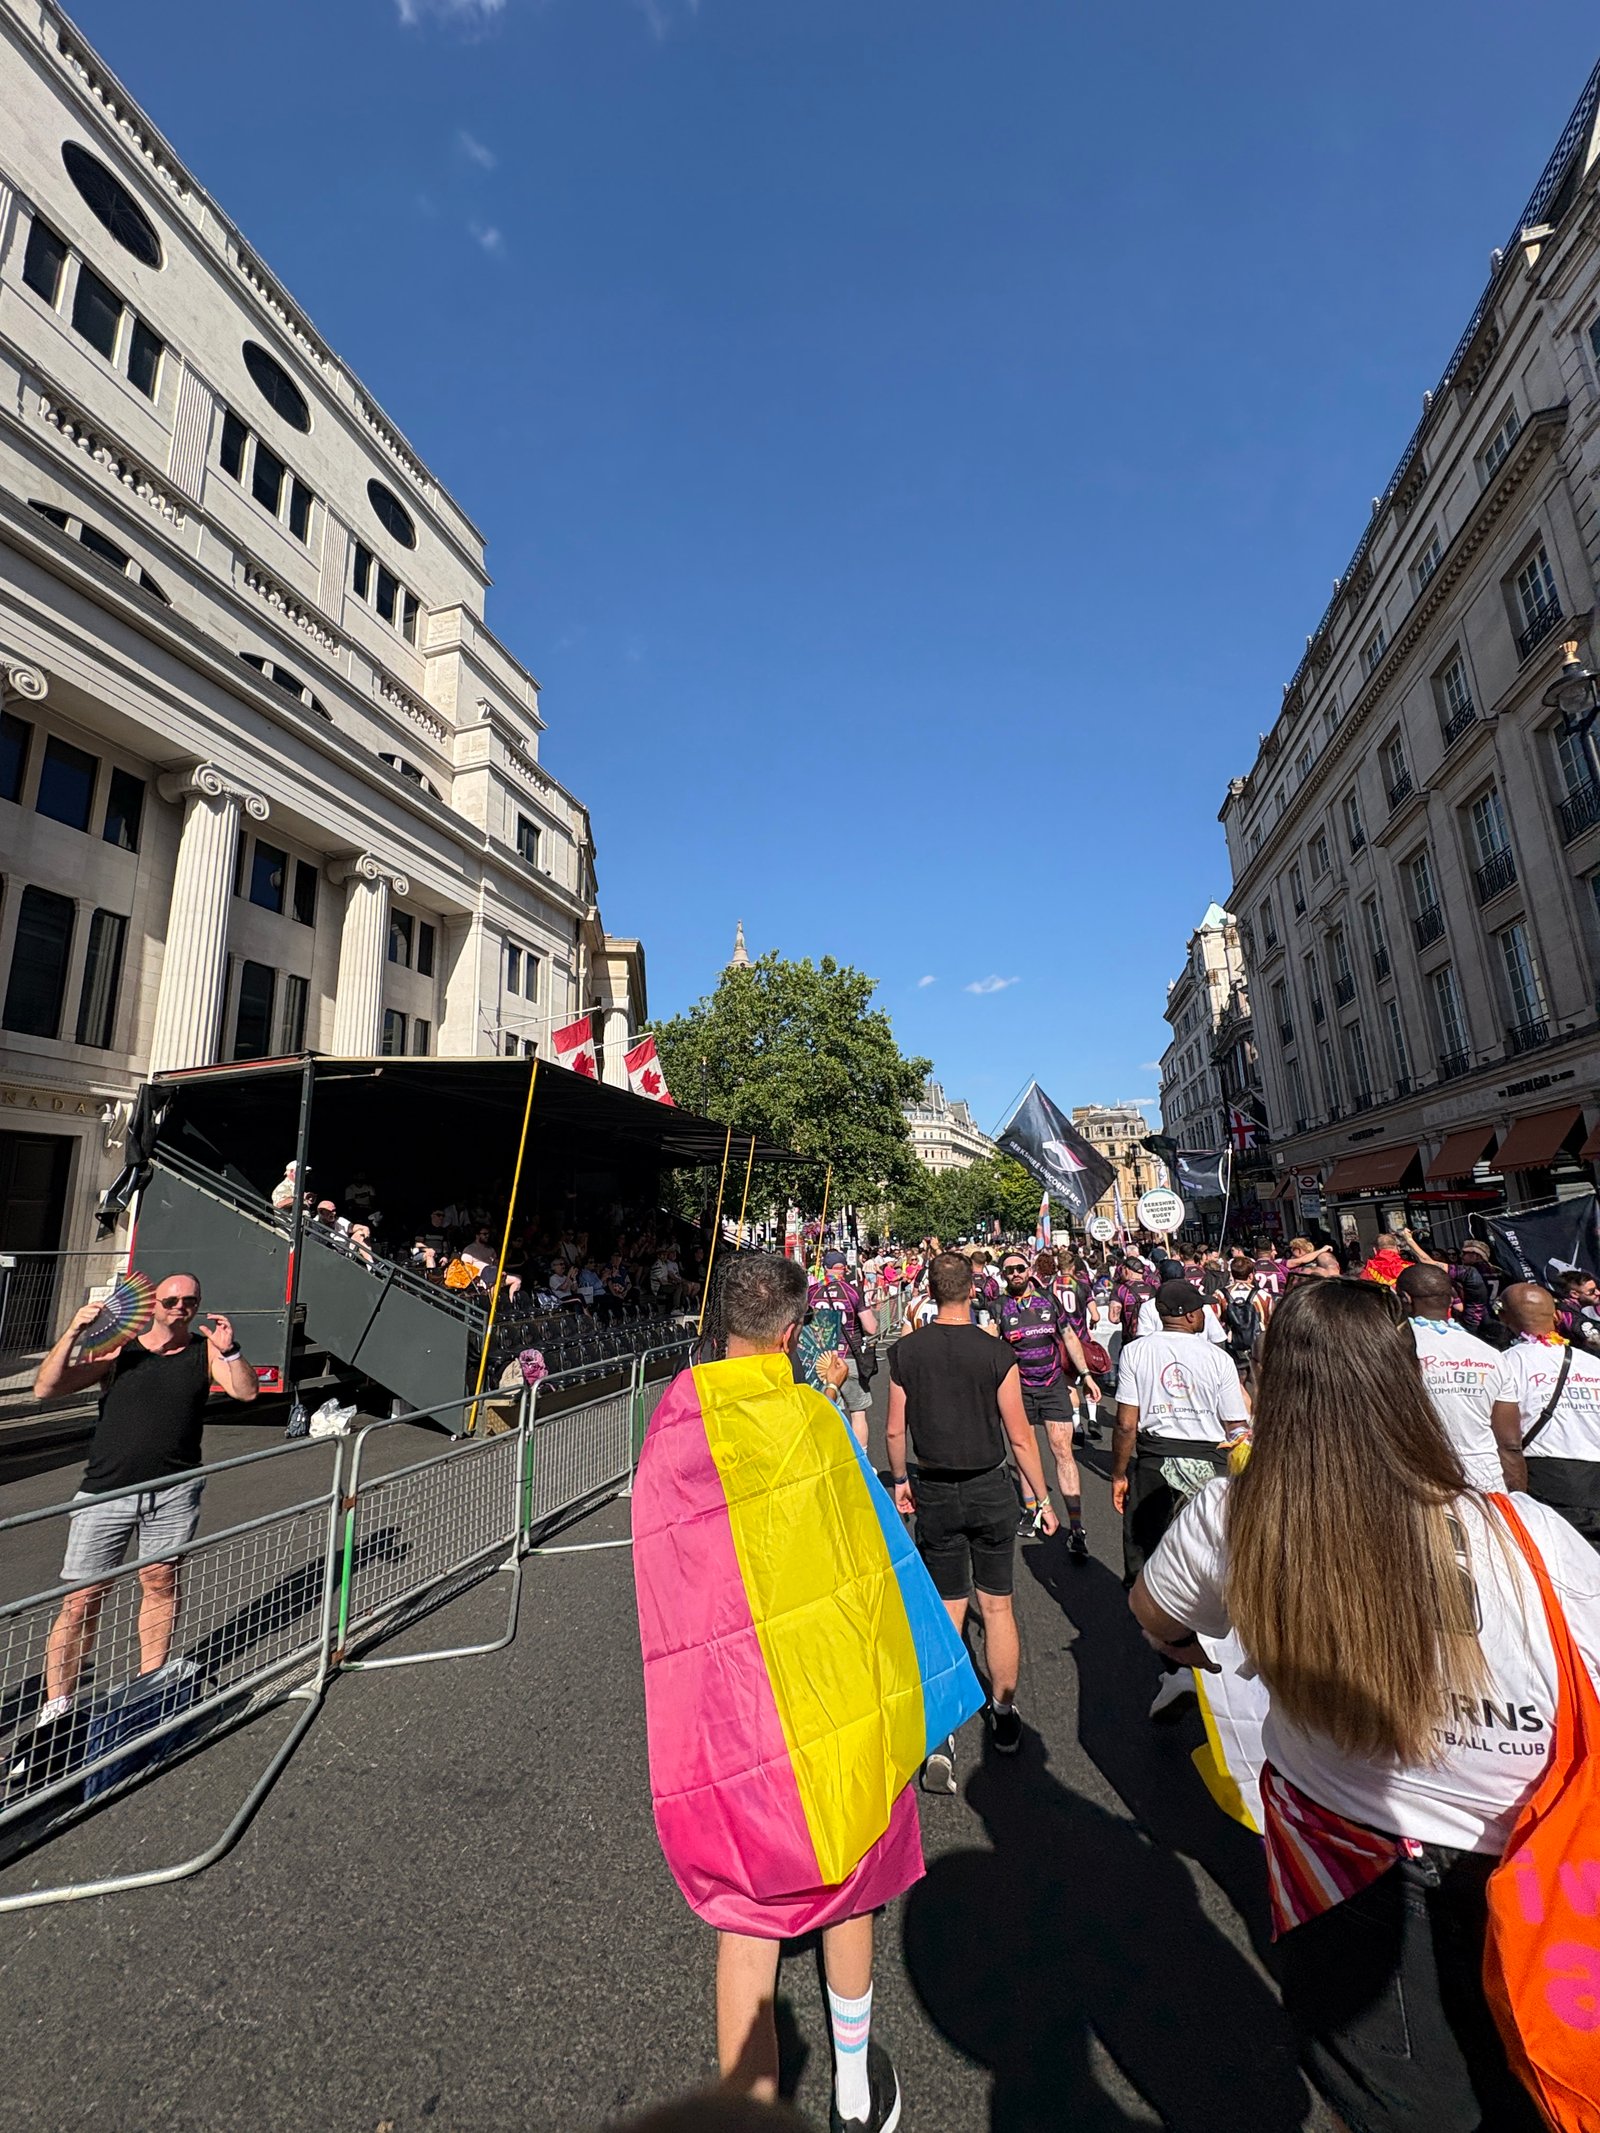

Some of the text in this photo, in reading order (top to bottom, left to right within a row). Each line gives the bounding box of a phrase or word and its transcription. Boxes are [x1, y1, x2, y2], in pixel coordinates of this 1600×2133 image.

[1009, 1141, 1082, 1207] BERKSHIRE UNICORNS RFC
[1144, 1200, 1176, 1208] BERKSHIRE
[1254, 1272, 1279, 1293] 21
[1446, 1371, 1488, 1386] LGBT
[1430, 1386, 1485, 1395] OMUNITY
[1450, 1692, 1544, 1733] RNS
[1497, 1741, 1546, 1756] CLUB
